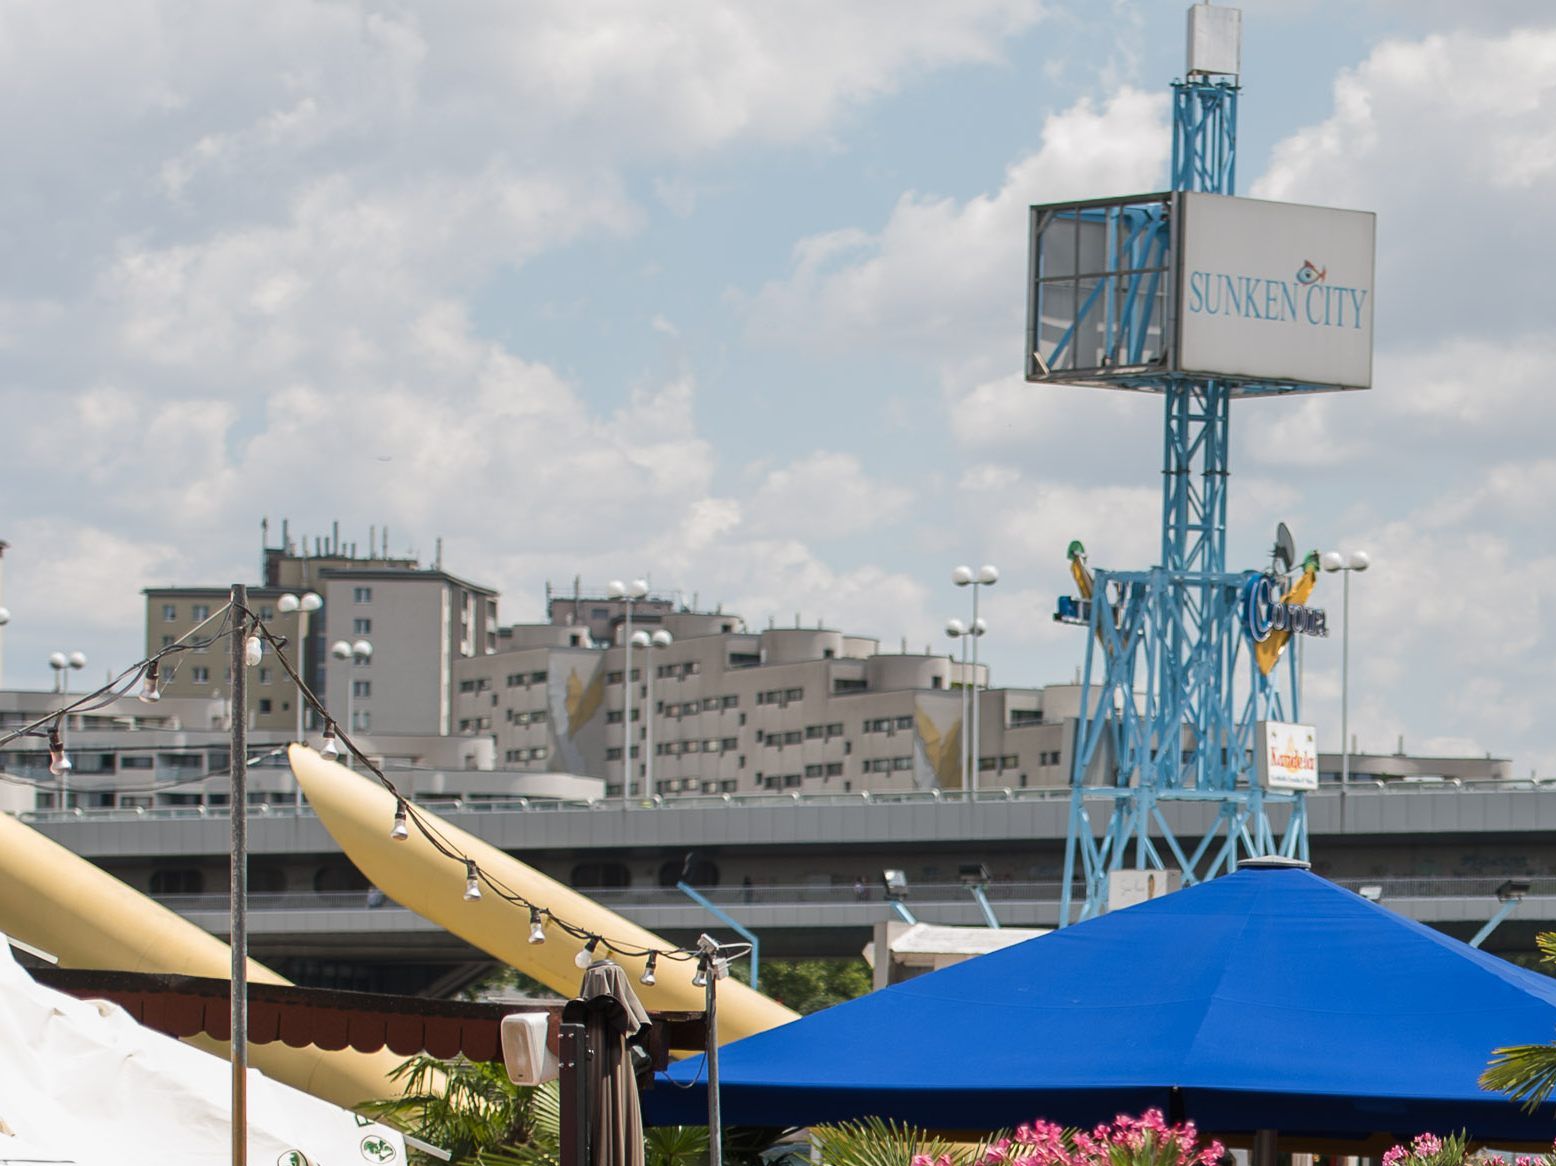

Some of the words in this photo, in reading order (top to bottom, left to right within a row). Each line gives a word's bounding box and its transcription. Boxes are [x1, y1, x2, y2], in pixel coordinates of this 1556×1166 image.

[1189, 271, 1299, 322] SUNKEN
[1306, 284, 1367, 329] CITY
[1244, 573, 1328, 643] Corona
